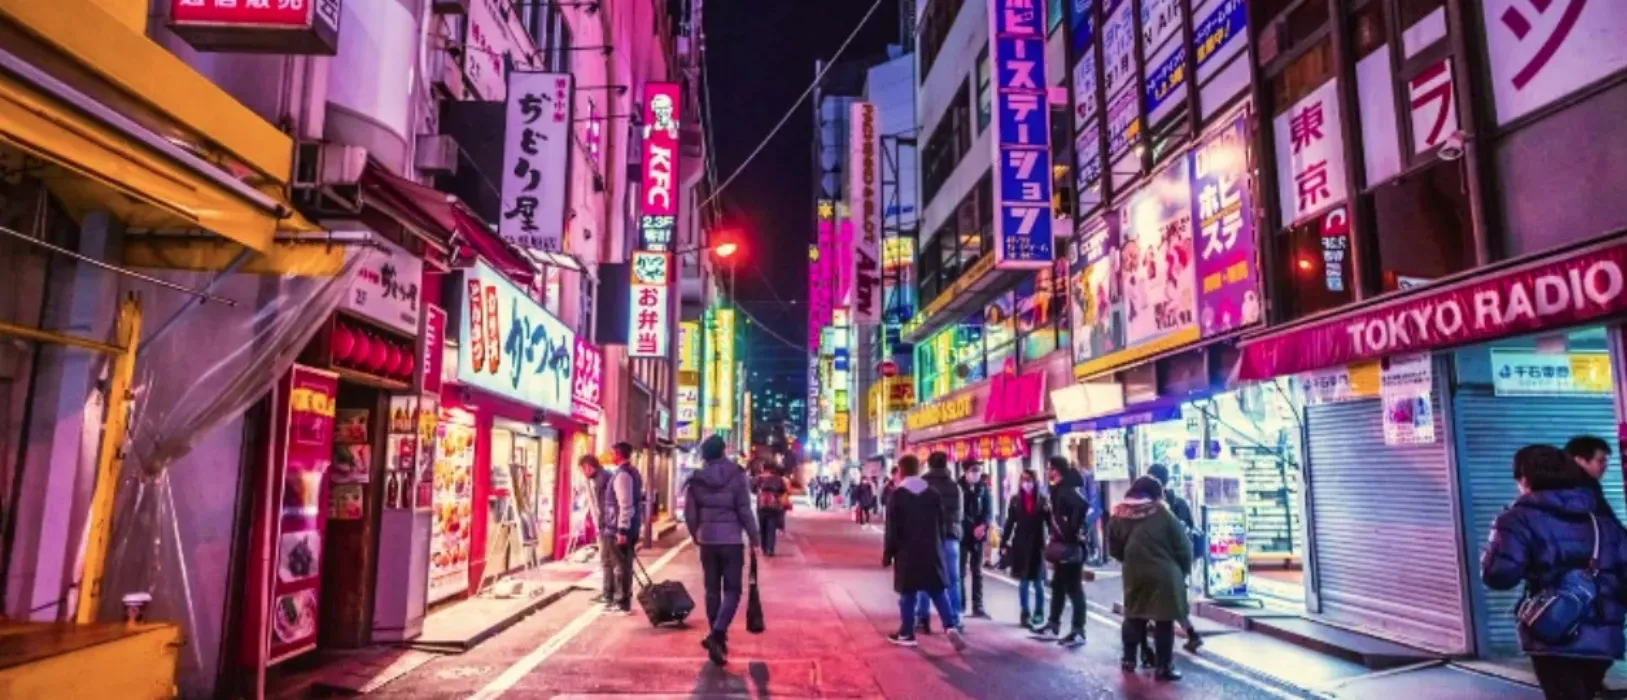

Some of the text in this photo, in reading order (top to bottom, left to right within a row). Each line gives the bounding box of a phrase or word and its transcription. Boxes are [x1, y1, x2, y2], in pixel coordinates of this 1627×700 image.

[1411, 58, 1453, 146] ラ
[504, 92, 551, 231] ぢどり屋
[648, 143, 672, 210] KFC
[1287, 100, 1332, 212] 東京
[504, 296, 571, 403] かつや
[636, 287, 659, 353] お弁当
[1347, 260, 1625, 354] TOKYO RADIO
